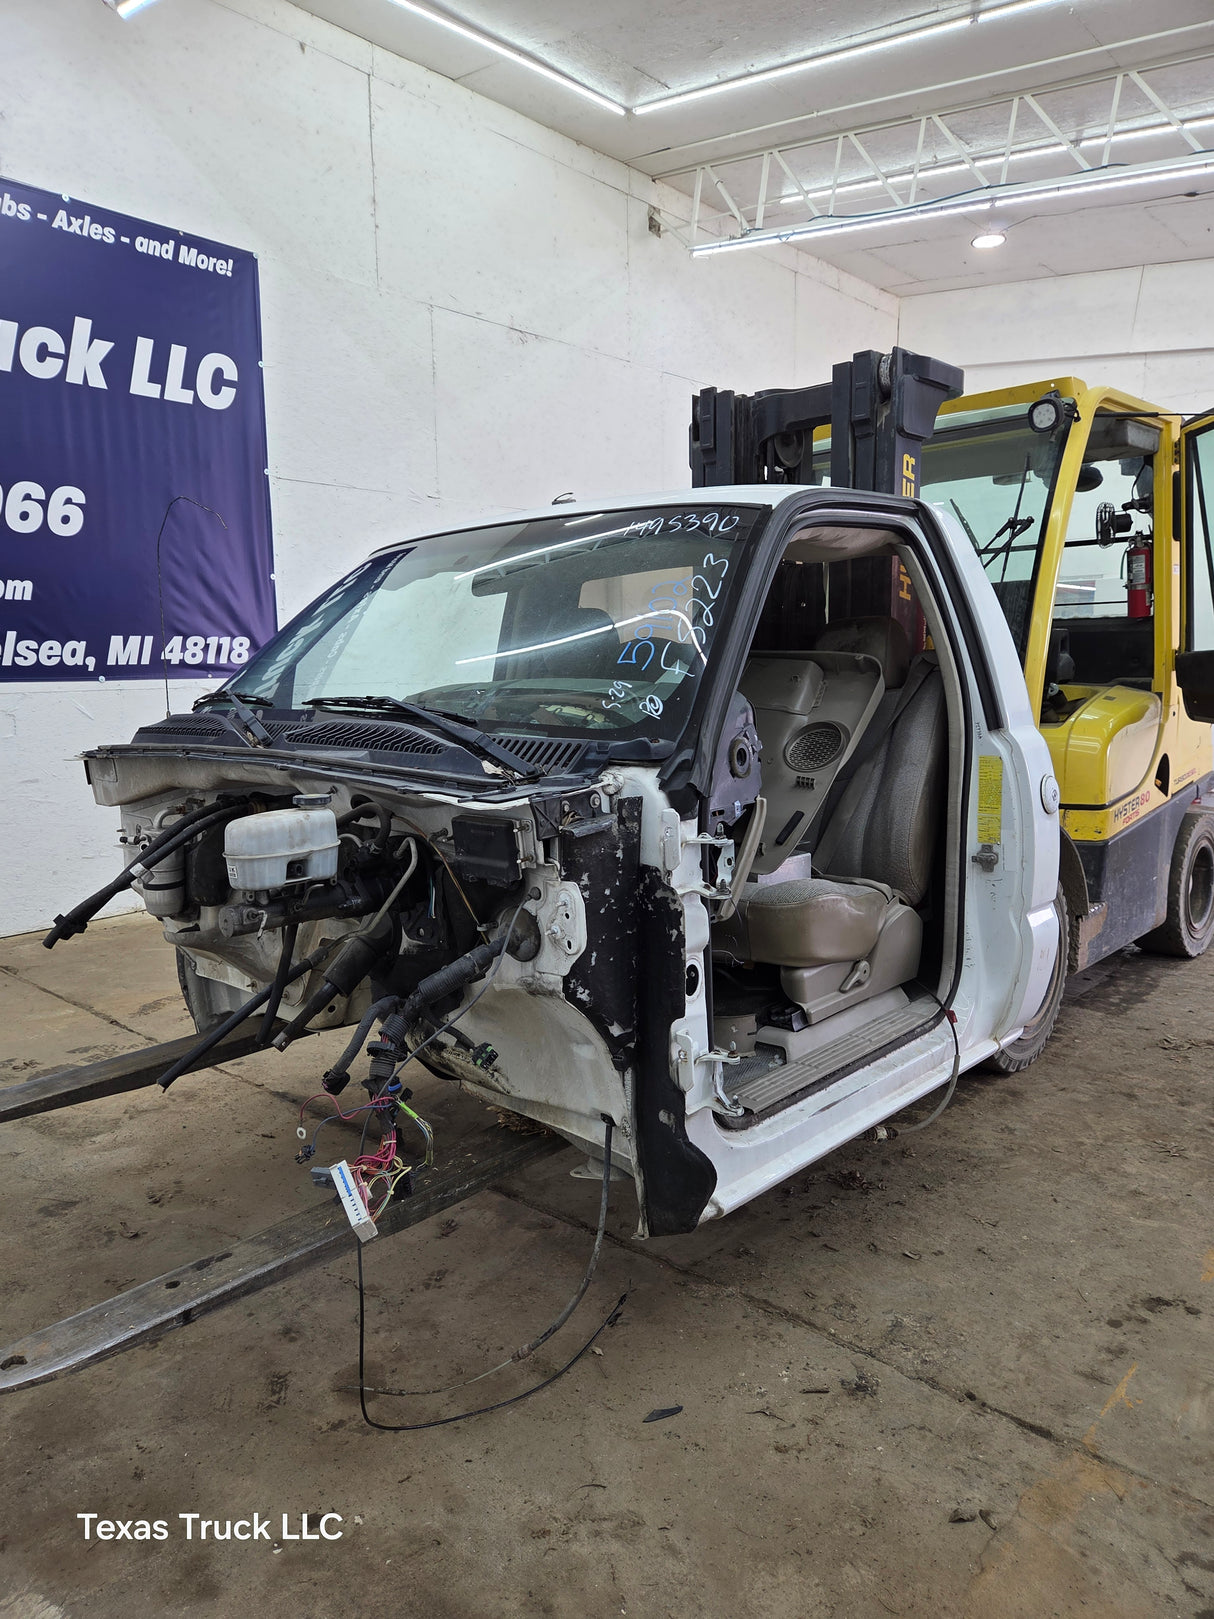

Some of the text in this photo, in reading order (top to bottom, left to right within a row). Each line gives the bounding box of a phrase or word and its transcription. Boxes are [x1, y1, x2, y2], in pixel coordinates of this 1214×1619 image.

[0, 193, 31, 221] bs
[51, 209, 116, 244] Axles
[135, 240, 175, 260] and
[178, 245, 234, 277] More!
[129, 336, 238, 410] LLC
[0, 480, 86, 537] 66
[0, 579, 34, 601] m
[0, 630, 250, 672] lsea, MI 48118
[1113, 790, 1151, 823] HYSTER 80
